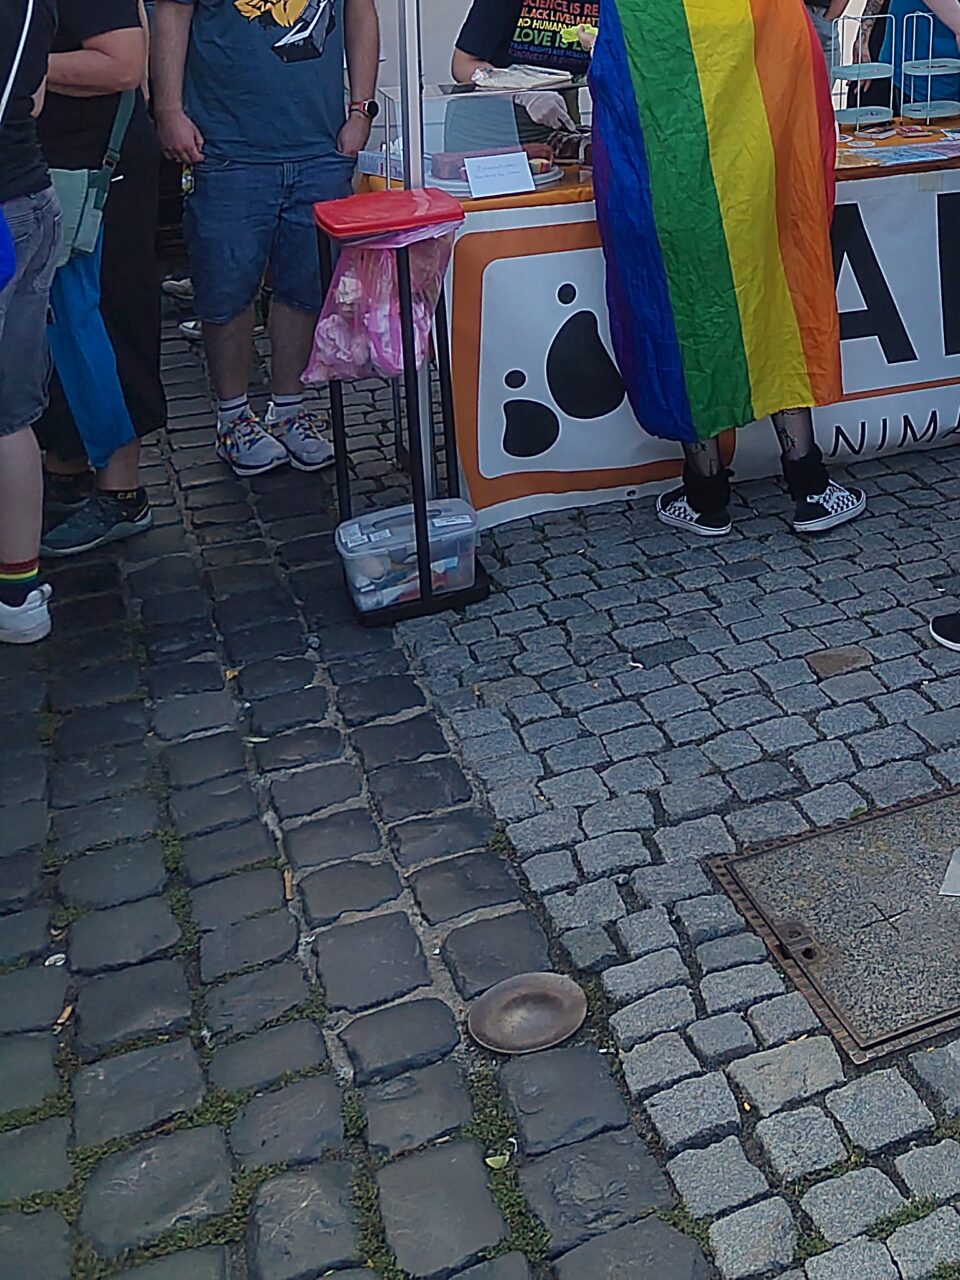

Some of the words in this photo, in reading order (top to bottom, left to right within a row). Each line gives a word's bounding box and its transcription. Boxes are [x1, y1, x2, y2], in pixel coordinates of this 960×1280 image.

[570, 2, 581, 15] IS
[583, 3, 599, 16] RE
[517, 17, 531, 27] NO
[512, 28, 553, 47] LOVE
[116, 491, 138, 500] CAT
